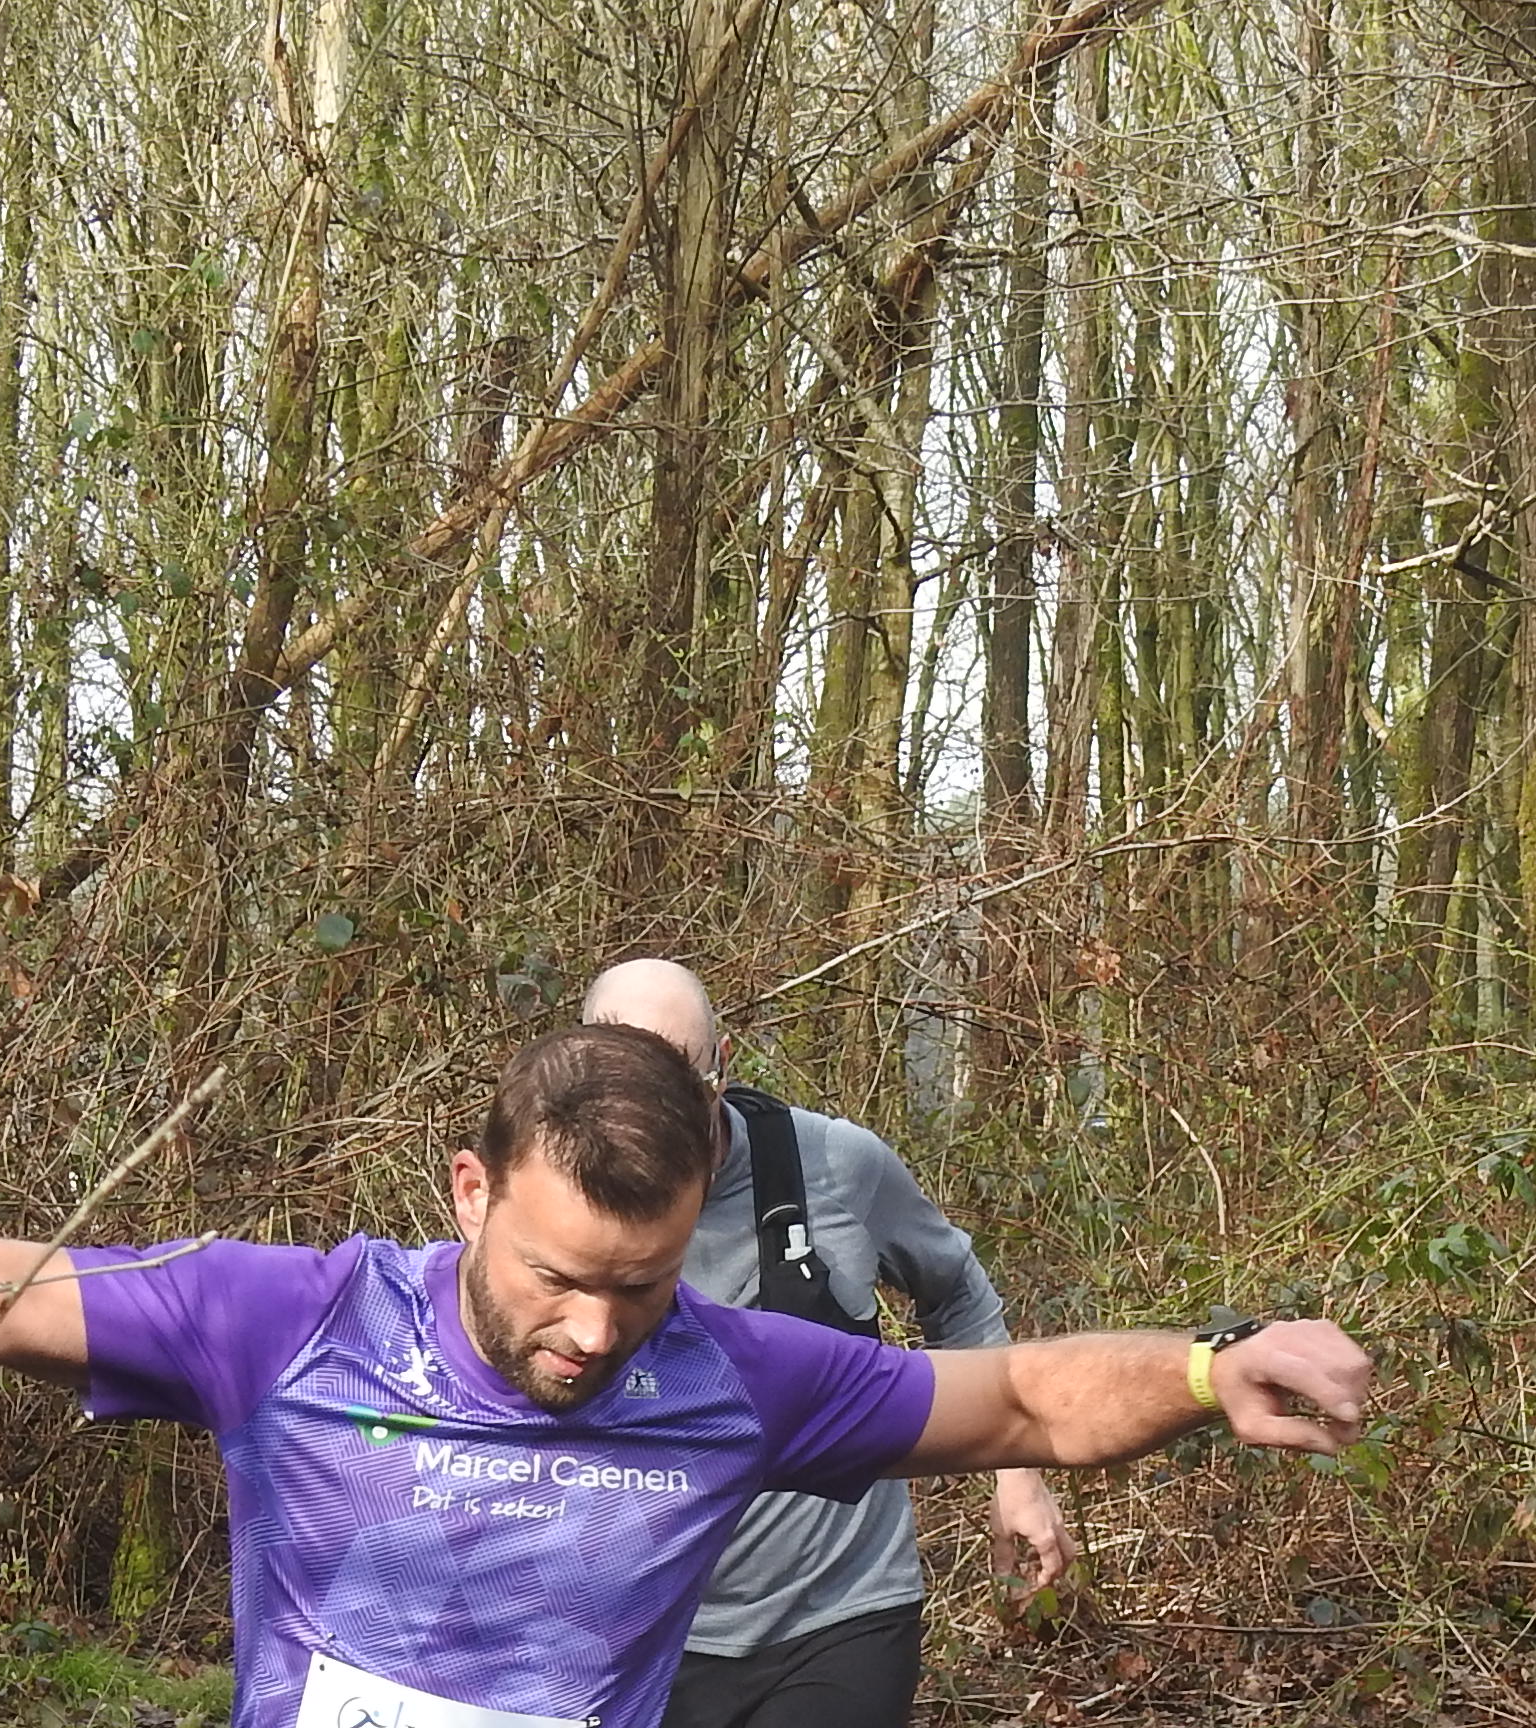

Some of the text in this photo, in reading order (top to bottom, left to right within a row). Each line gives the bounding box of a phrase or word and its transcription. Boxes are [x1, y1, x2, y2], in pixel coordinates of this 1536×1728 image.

[415, 1443, 689, 1492] Marcel Caenen
[412, 1486, 566, 1522] Dat is zeker!
